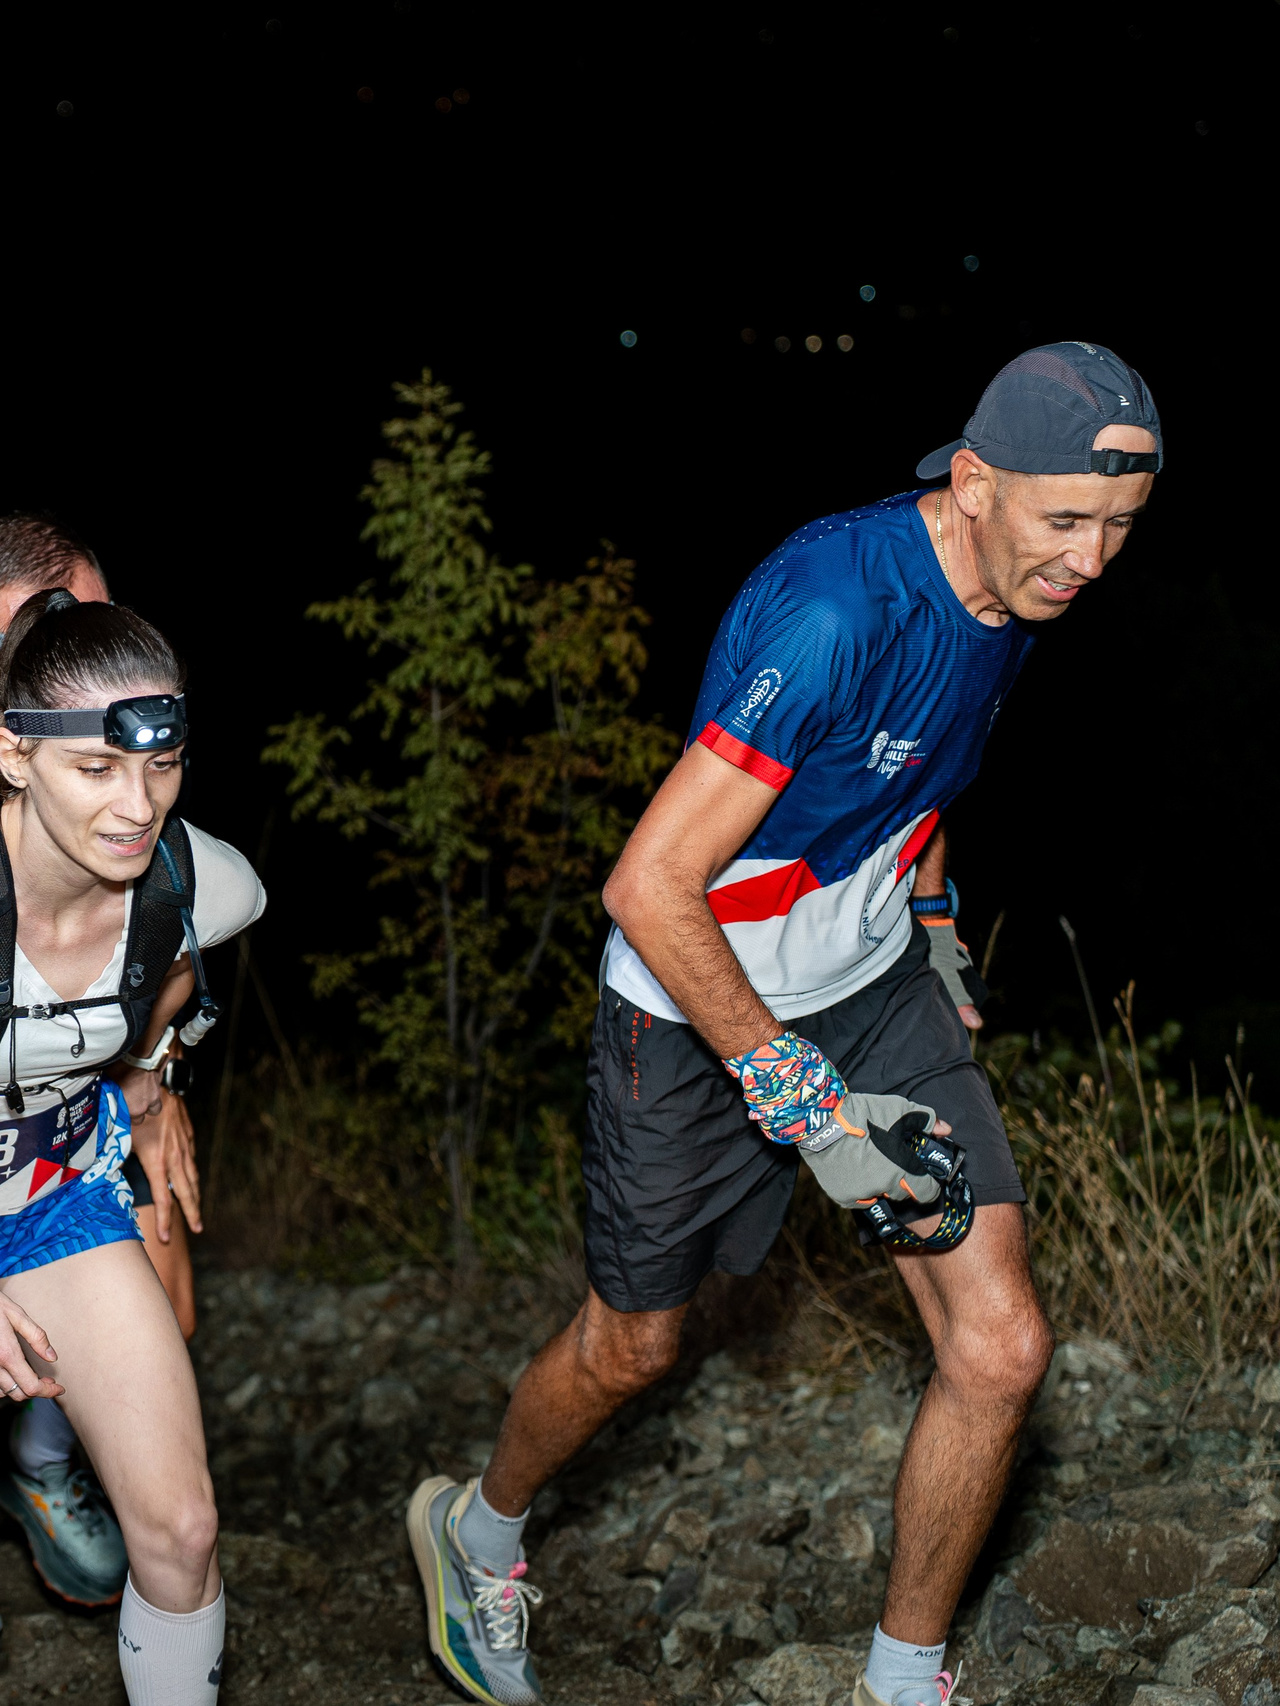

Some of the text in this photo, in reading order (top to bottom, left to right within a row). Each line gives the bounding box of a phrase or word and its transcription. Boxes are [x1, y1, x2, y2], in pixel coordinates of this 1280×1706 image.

[747, 678, 758, 694] THE
[883, 750, 909, 762] HILLS
[877, 760, 906, 780] Nigh
[887, 858, 910, 875] STEP
[52, 1130, 68, 1146] 12K
